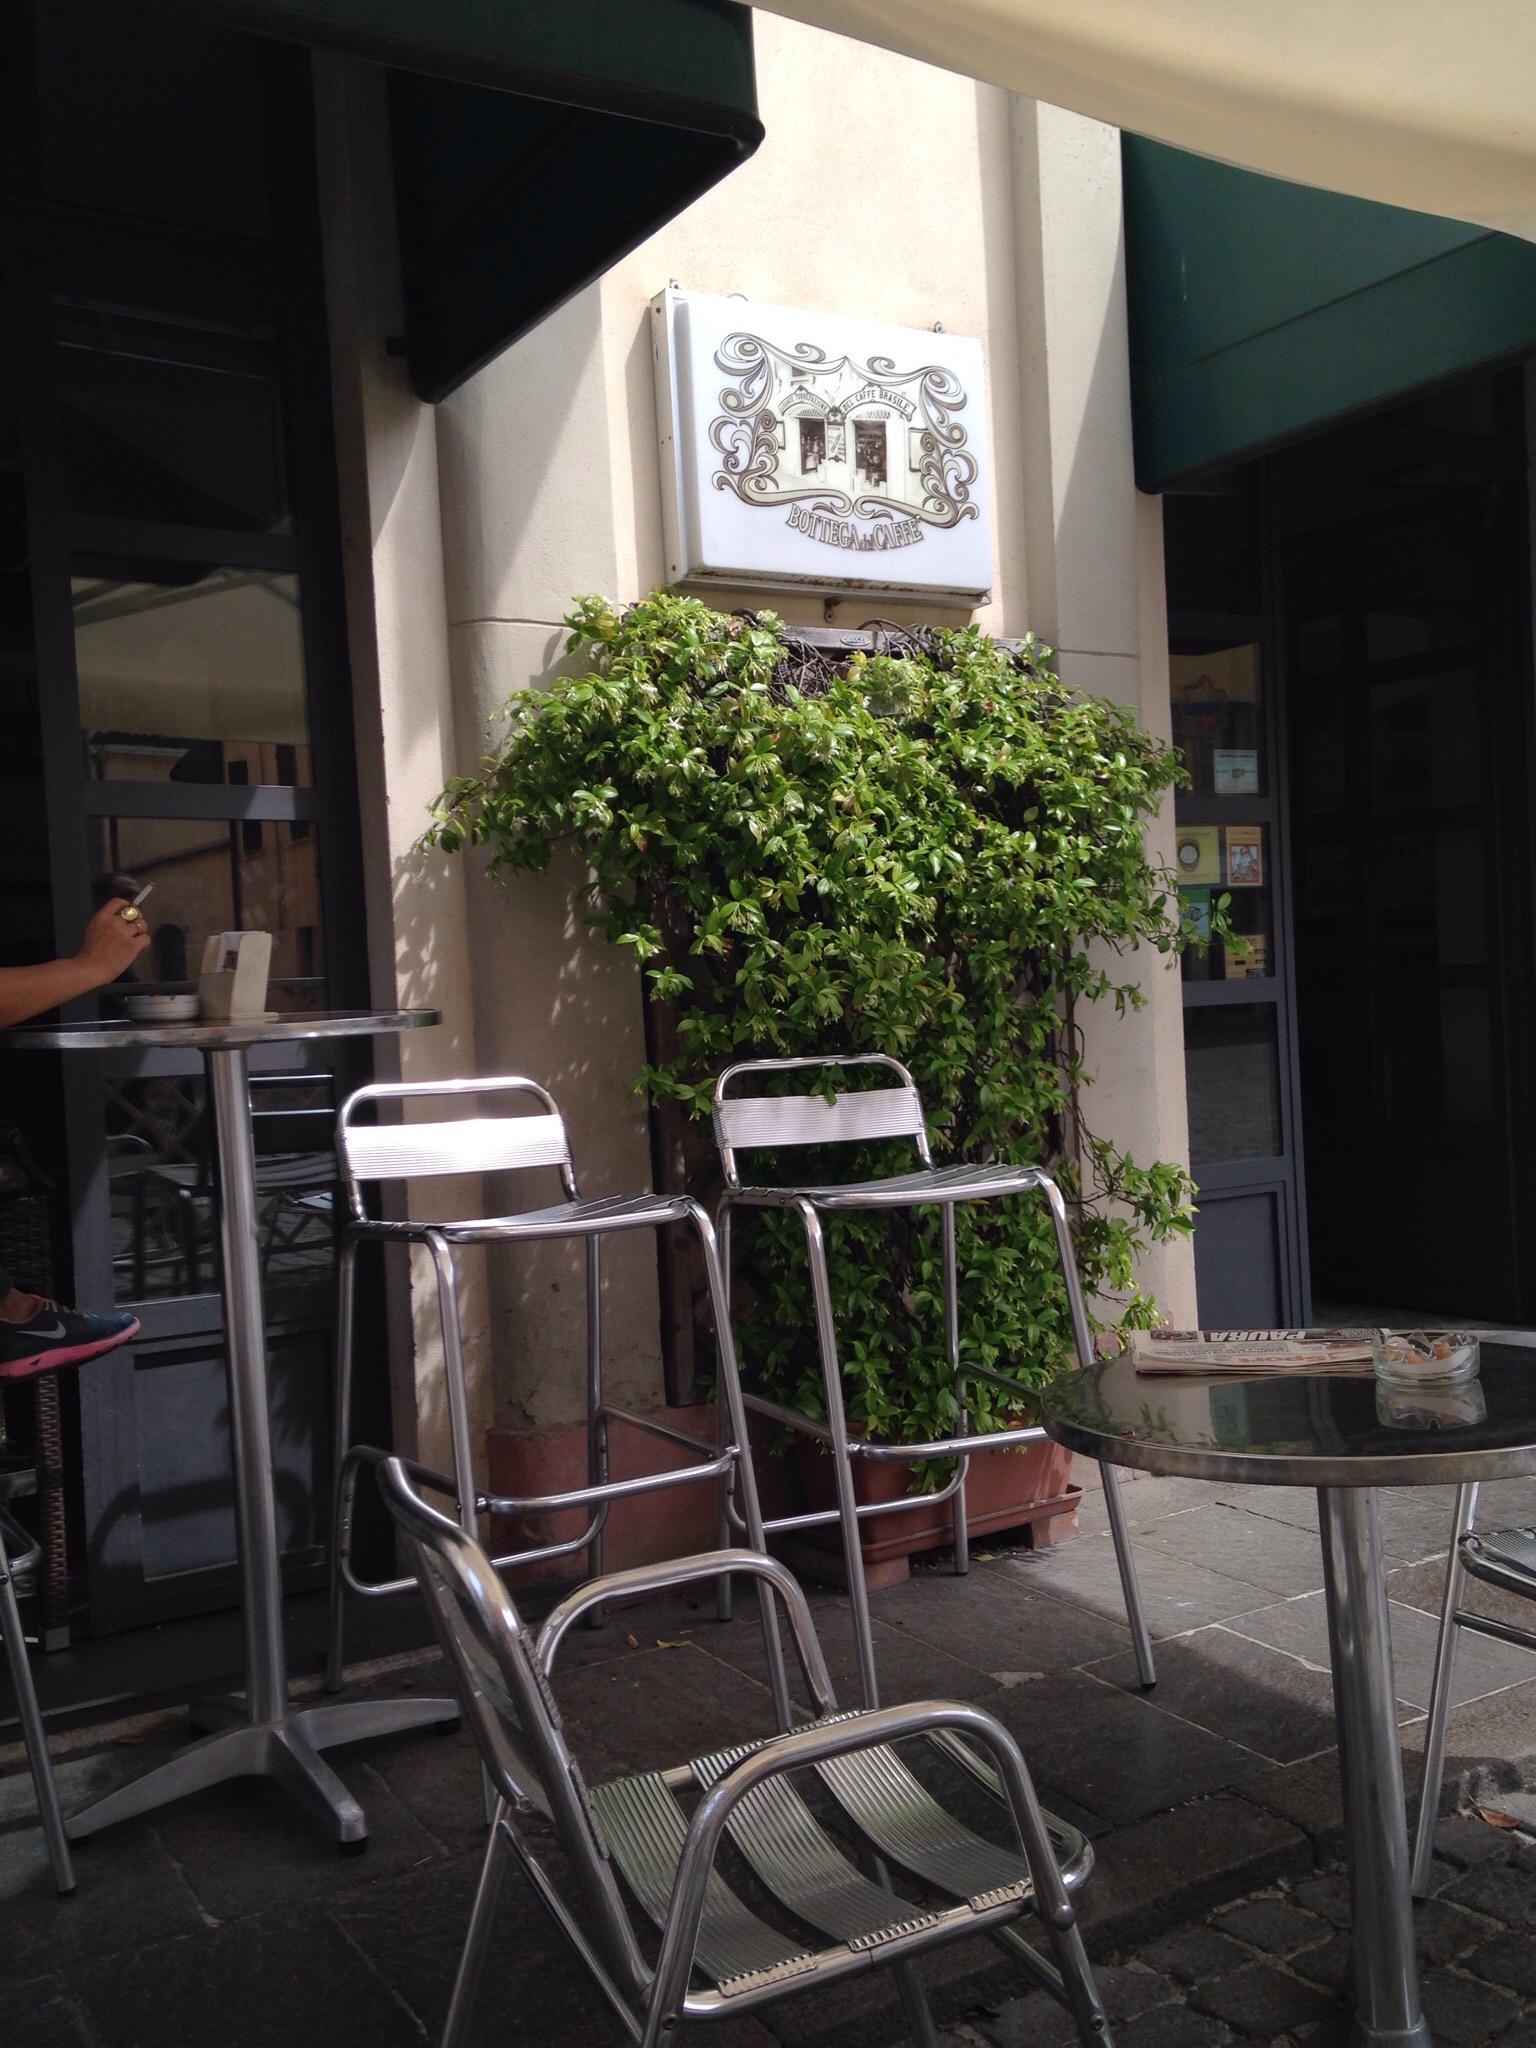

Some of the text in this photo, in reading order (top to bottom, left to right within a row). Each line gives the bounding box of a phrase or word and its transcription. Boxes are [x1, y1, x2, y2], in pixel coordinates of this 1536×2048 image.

[843, 400, 855, 412] DEL
[879, 388, 910, 413] BRASILE
[785, 503, 860, 549] BOTTEGA
[1210, 1330, 1307, 1342] PAURA
